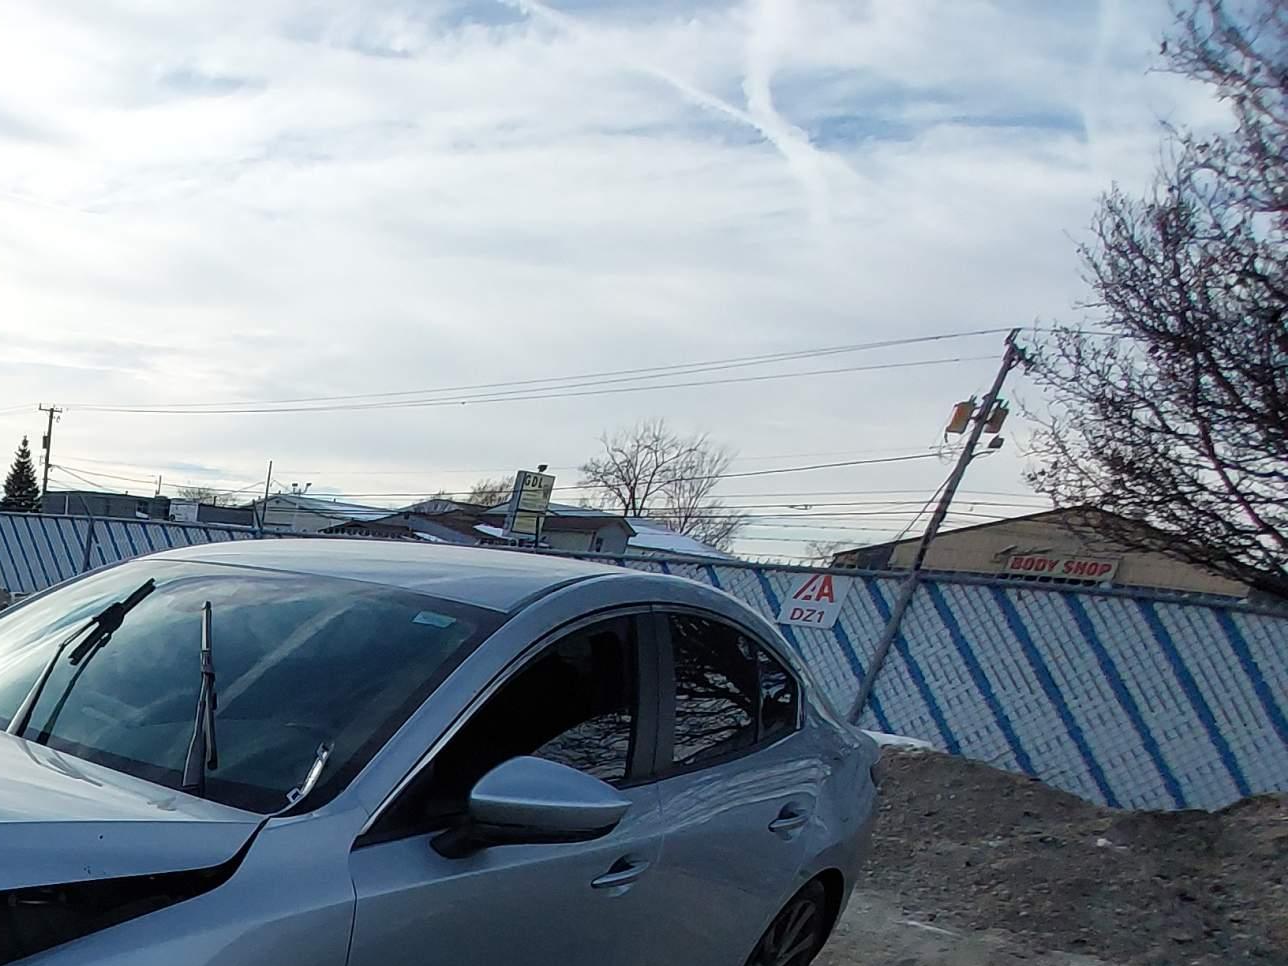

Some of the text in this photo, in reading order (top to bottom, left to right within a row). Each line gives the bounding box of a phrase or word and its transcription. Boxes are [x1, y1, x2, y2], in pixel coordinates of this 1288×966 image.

[524, 474, 543, 489] GDL
[1010, 556, 1113, 577] BODY SHOP
[790, 607, 825, 624] DZ1
